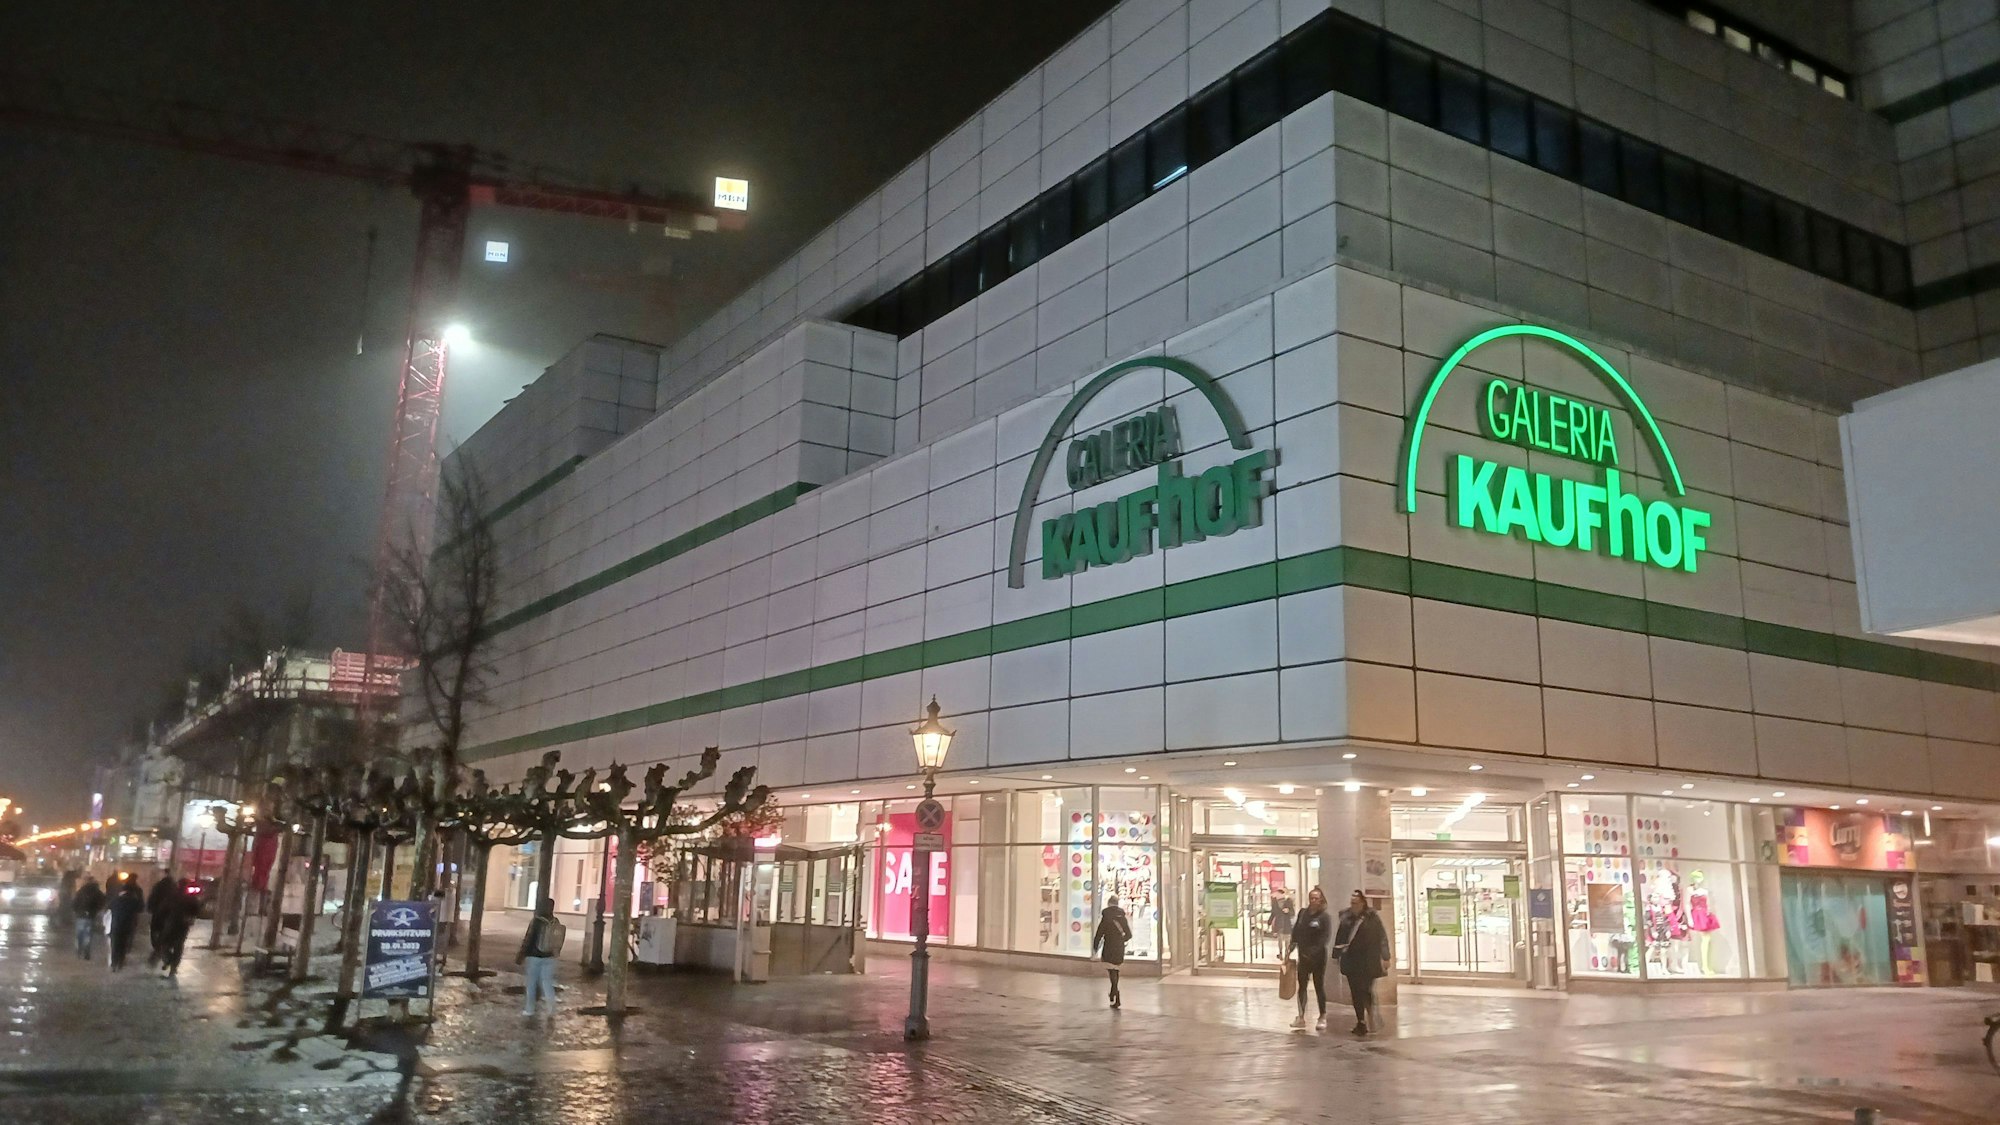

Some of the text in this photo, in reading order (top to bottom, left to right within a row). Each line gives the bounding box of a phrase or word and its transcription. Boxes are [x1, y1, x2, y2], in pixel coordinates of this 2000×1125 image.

[1067, 405, 1183, 490] GALERIA
[1487, 379, 1619, 465] GALERIA
[884, 851, 948, 896] SAE
